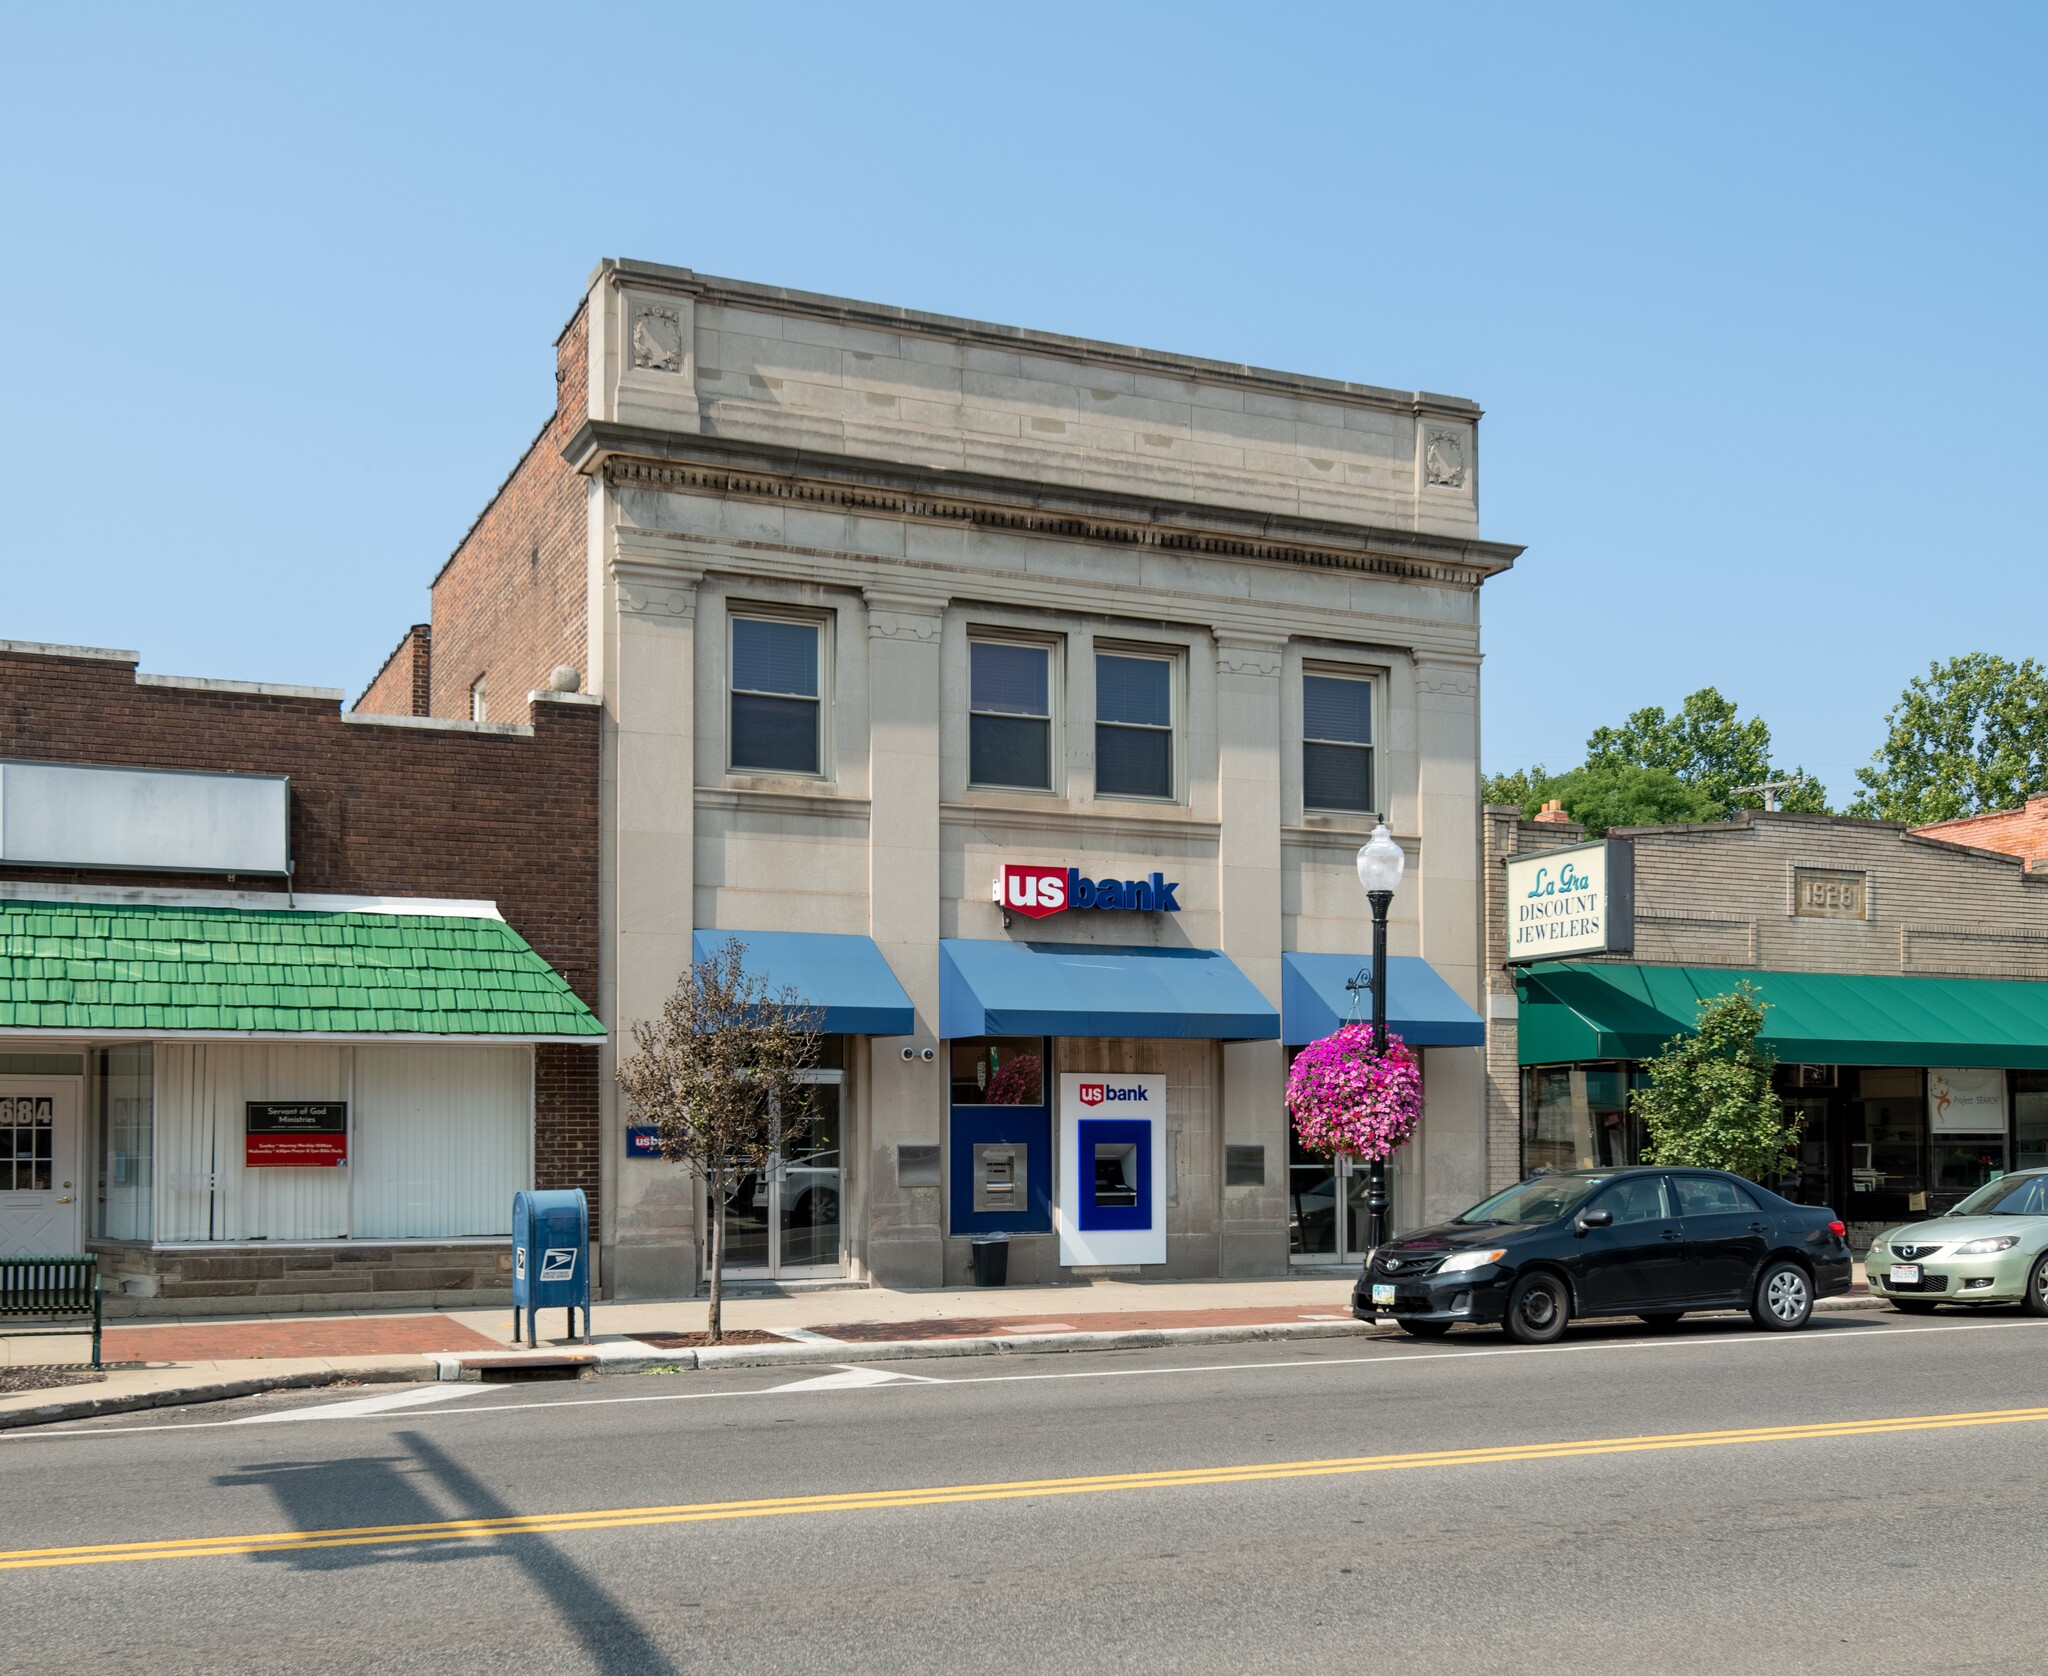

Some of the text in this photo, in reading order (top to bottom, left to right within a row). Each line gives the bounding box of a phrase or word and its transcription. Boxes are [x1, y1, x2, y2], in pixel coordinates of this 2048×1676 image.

[1527, 863, 1589, 899] La Gra
[1806, 882, 1855, 906] 1928
[1519, 893, 1597, 922] DISCOUNT
[1516, 916, 1600, 944] JEWELERS
[0, 1100, 52, 1124] 684
[267, 1107, 327, 1115] Servant of God
[1953, 1096, 1974, 1106] Project
